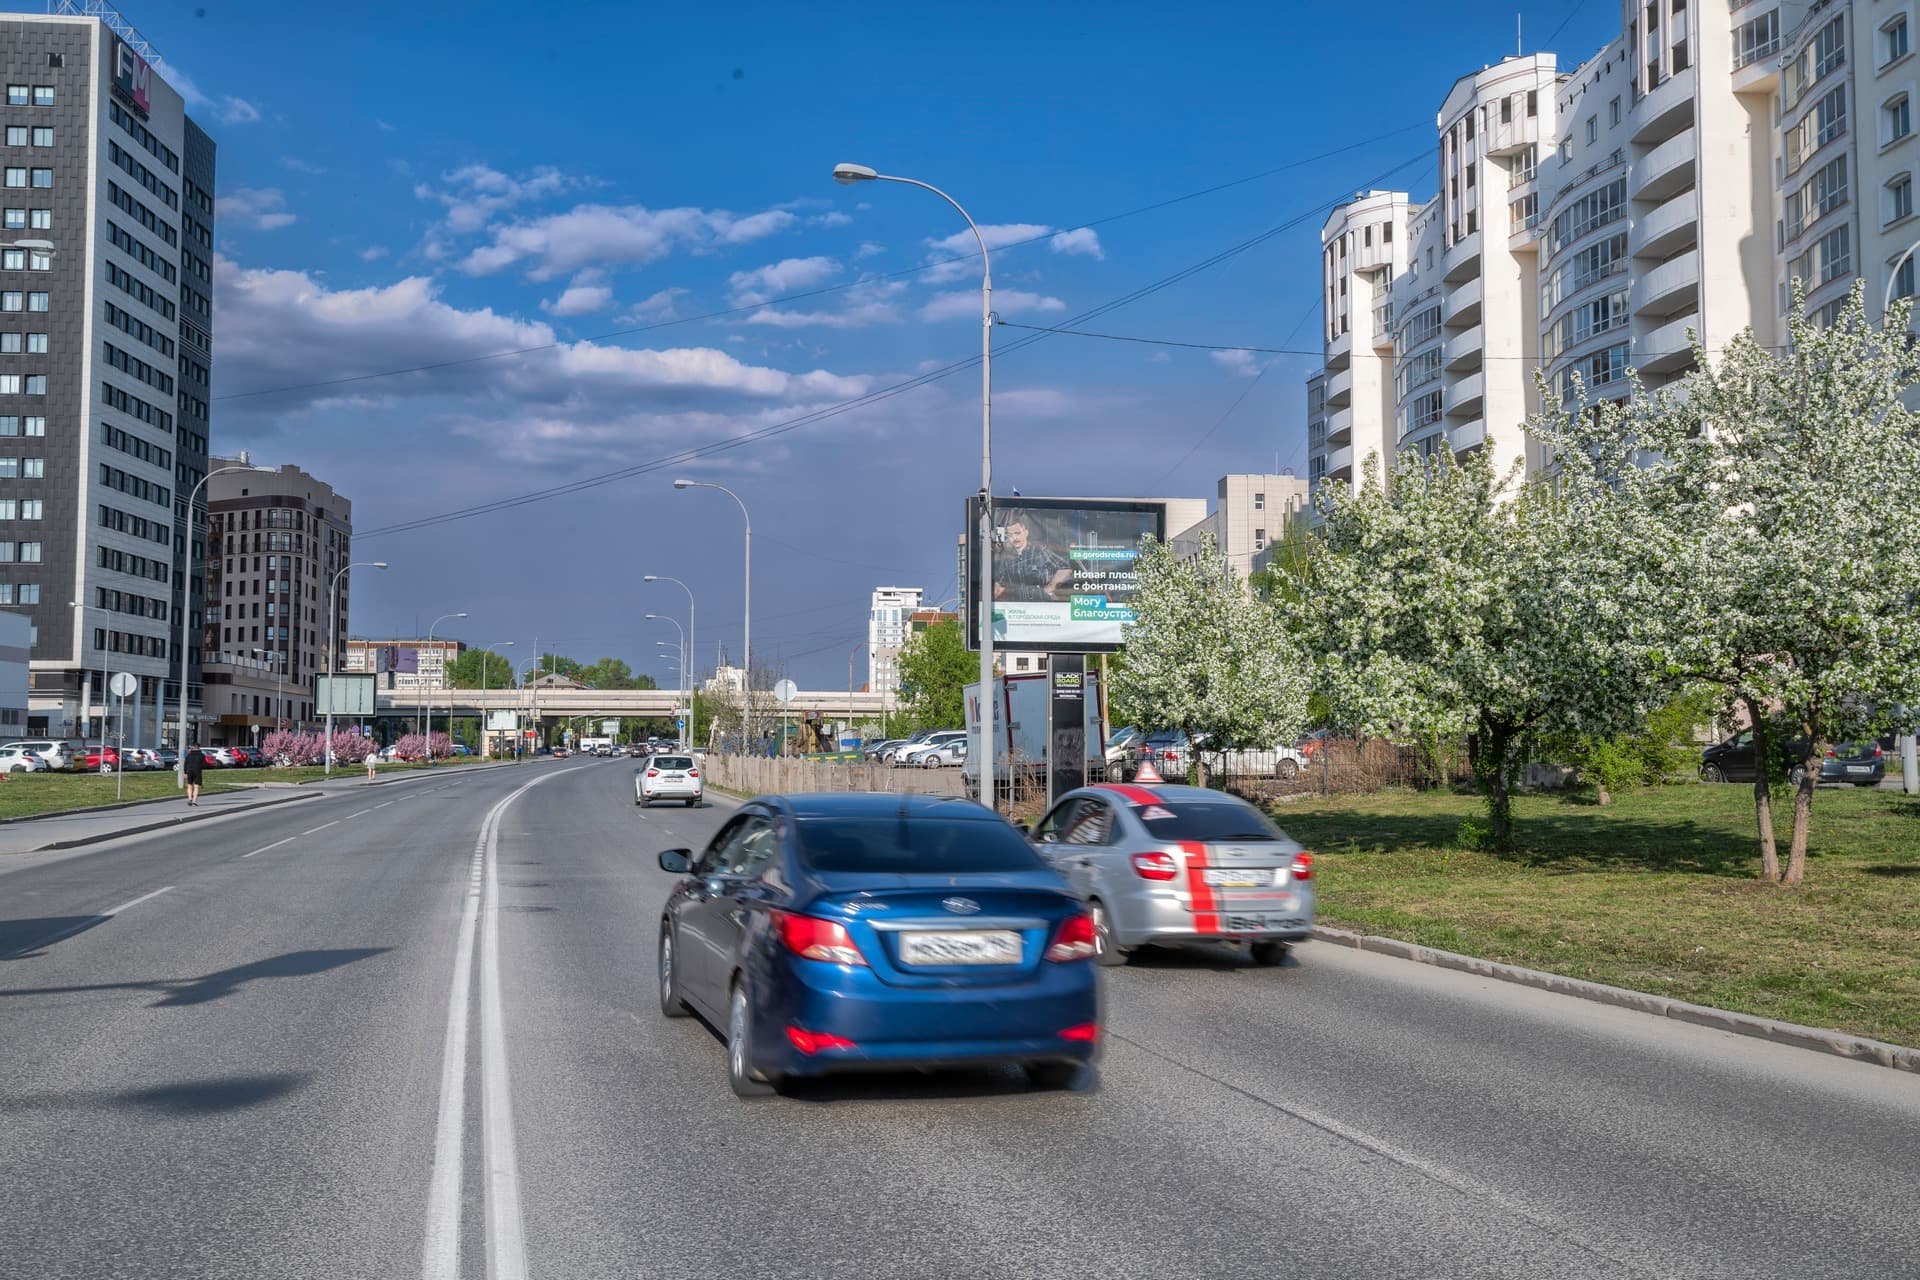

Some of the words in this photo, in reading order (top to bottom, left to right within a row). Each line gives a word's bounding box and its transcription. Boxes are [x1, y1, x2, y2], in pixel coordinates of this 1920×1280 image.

[1074, 569, 1106, 579] Новая
[1109, 571, 1138, 580] площ
[1075, 598, 1101, 608] Могу
[1074, 608, 1134, 619] благоустро
